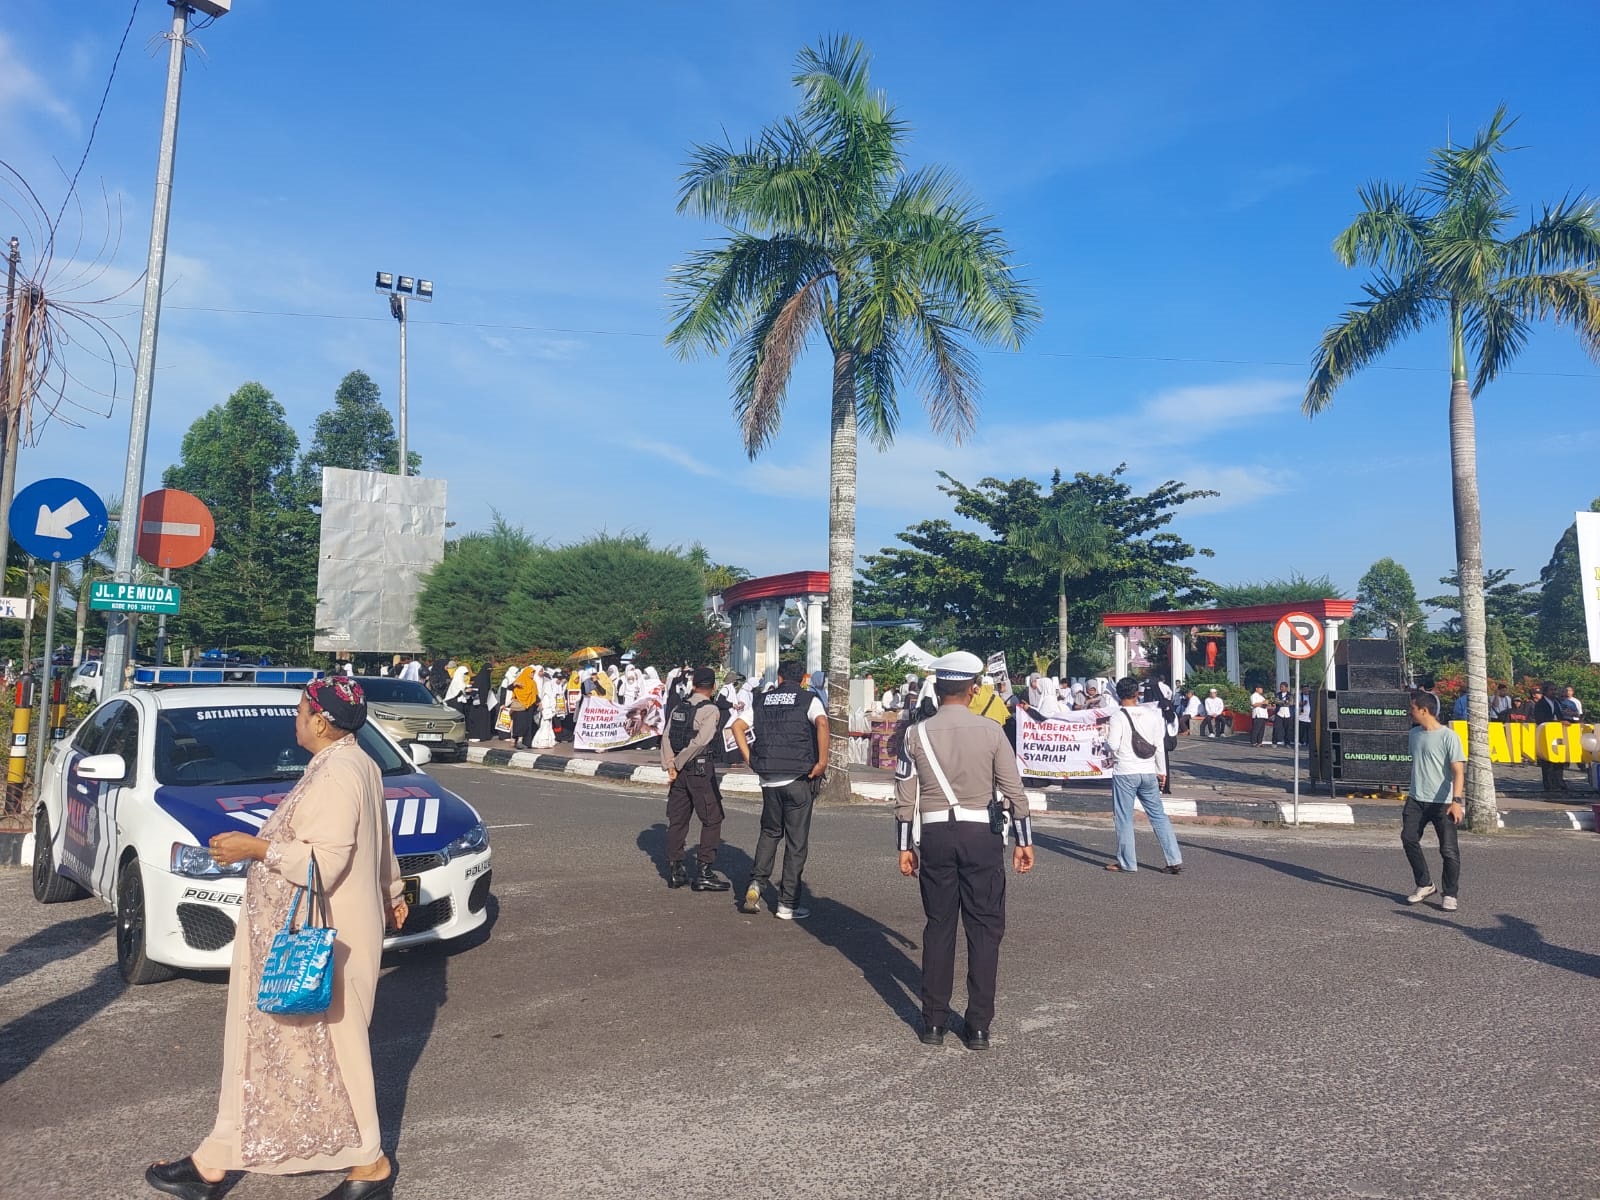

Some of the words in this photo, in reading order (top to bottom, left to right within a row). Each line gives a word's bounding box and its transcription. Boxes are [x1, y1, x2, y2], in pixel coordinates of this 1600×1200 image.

[95, 584, 114, 598] JL.
[118, 585, 173, 601] PEMUDA
[196, 708, 259, 721] SATLANTAS
[260, 708, 299, 717] POLRES
[1340, 707, 1383, 716] GANDRUNG
[582, 720, 627, 730] SELAMATKAN
[1023, 721, 1101, 732] MEMBEBASKAN
[1023, 731, 1076, 742] PALESTINA
[1023, 742, 1081, 752] KEWAJIBAN
[1023, 752, 1067, 763] SYARIAH
[1344, 752, 1387, 761] GANDRUNG
[1388, 754, 1413, 762] MUSIC
